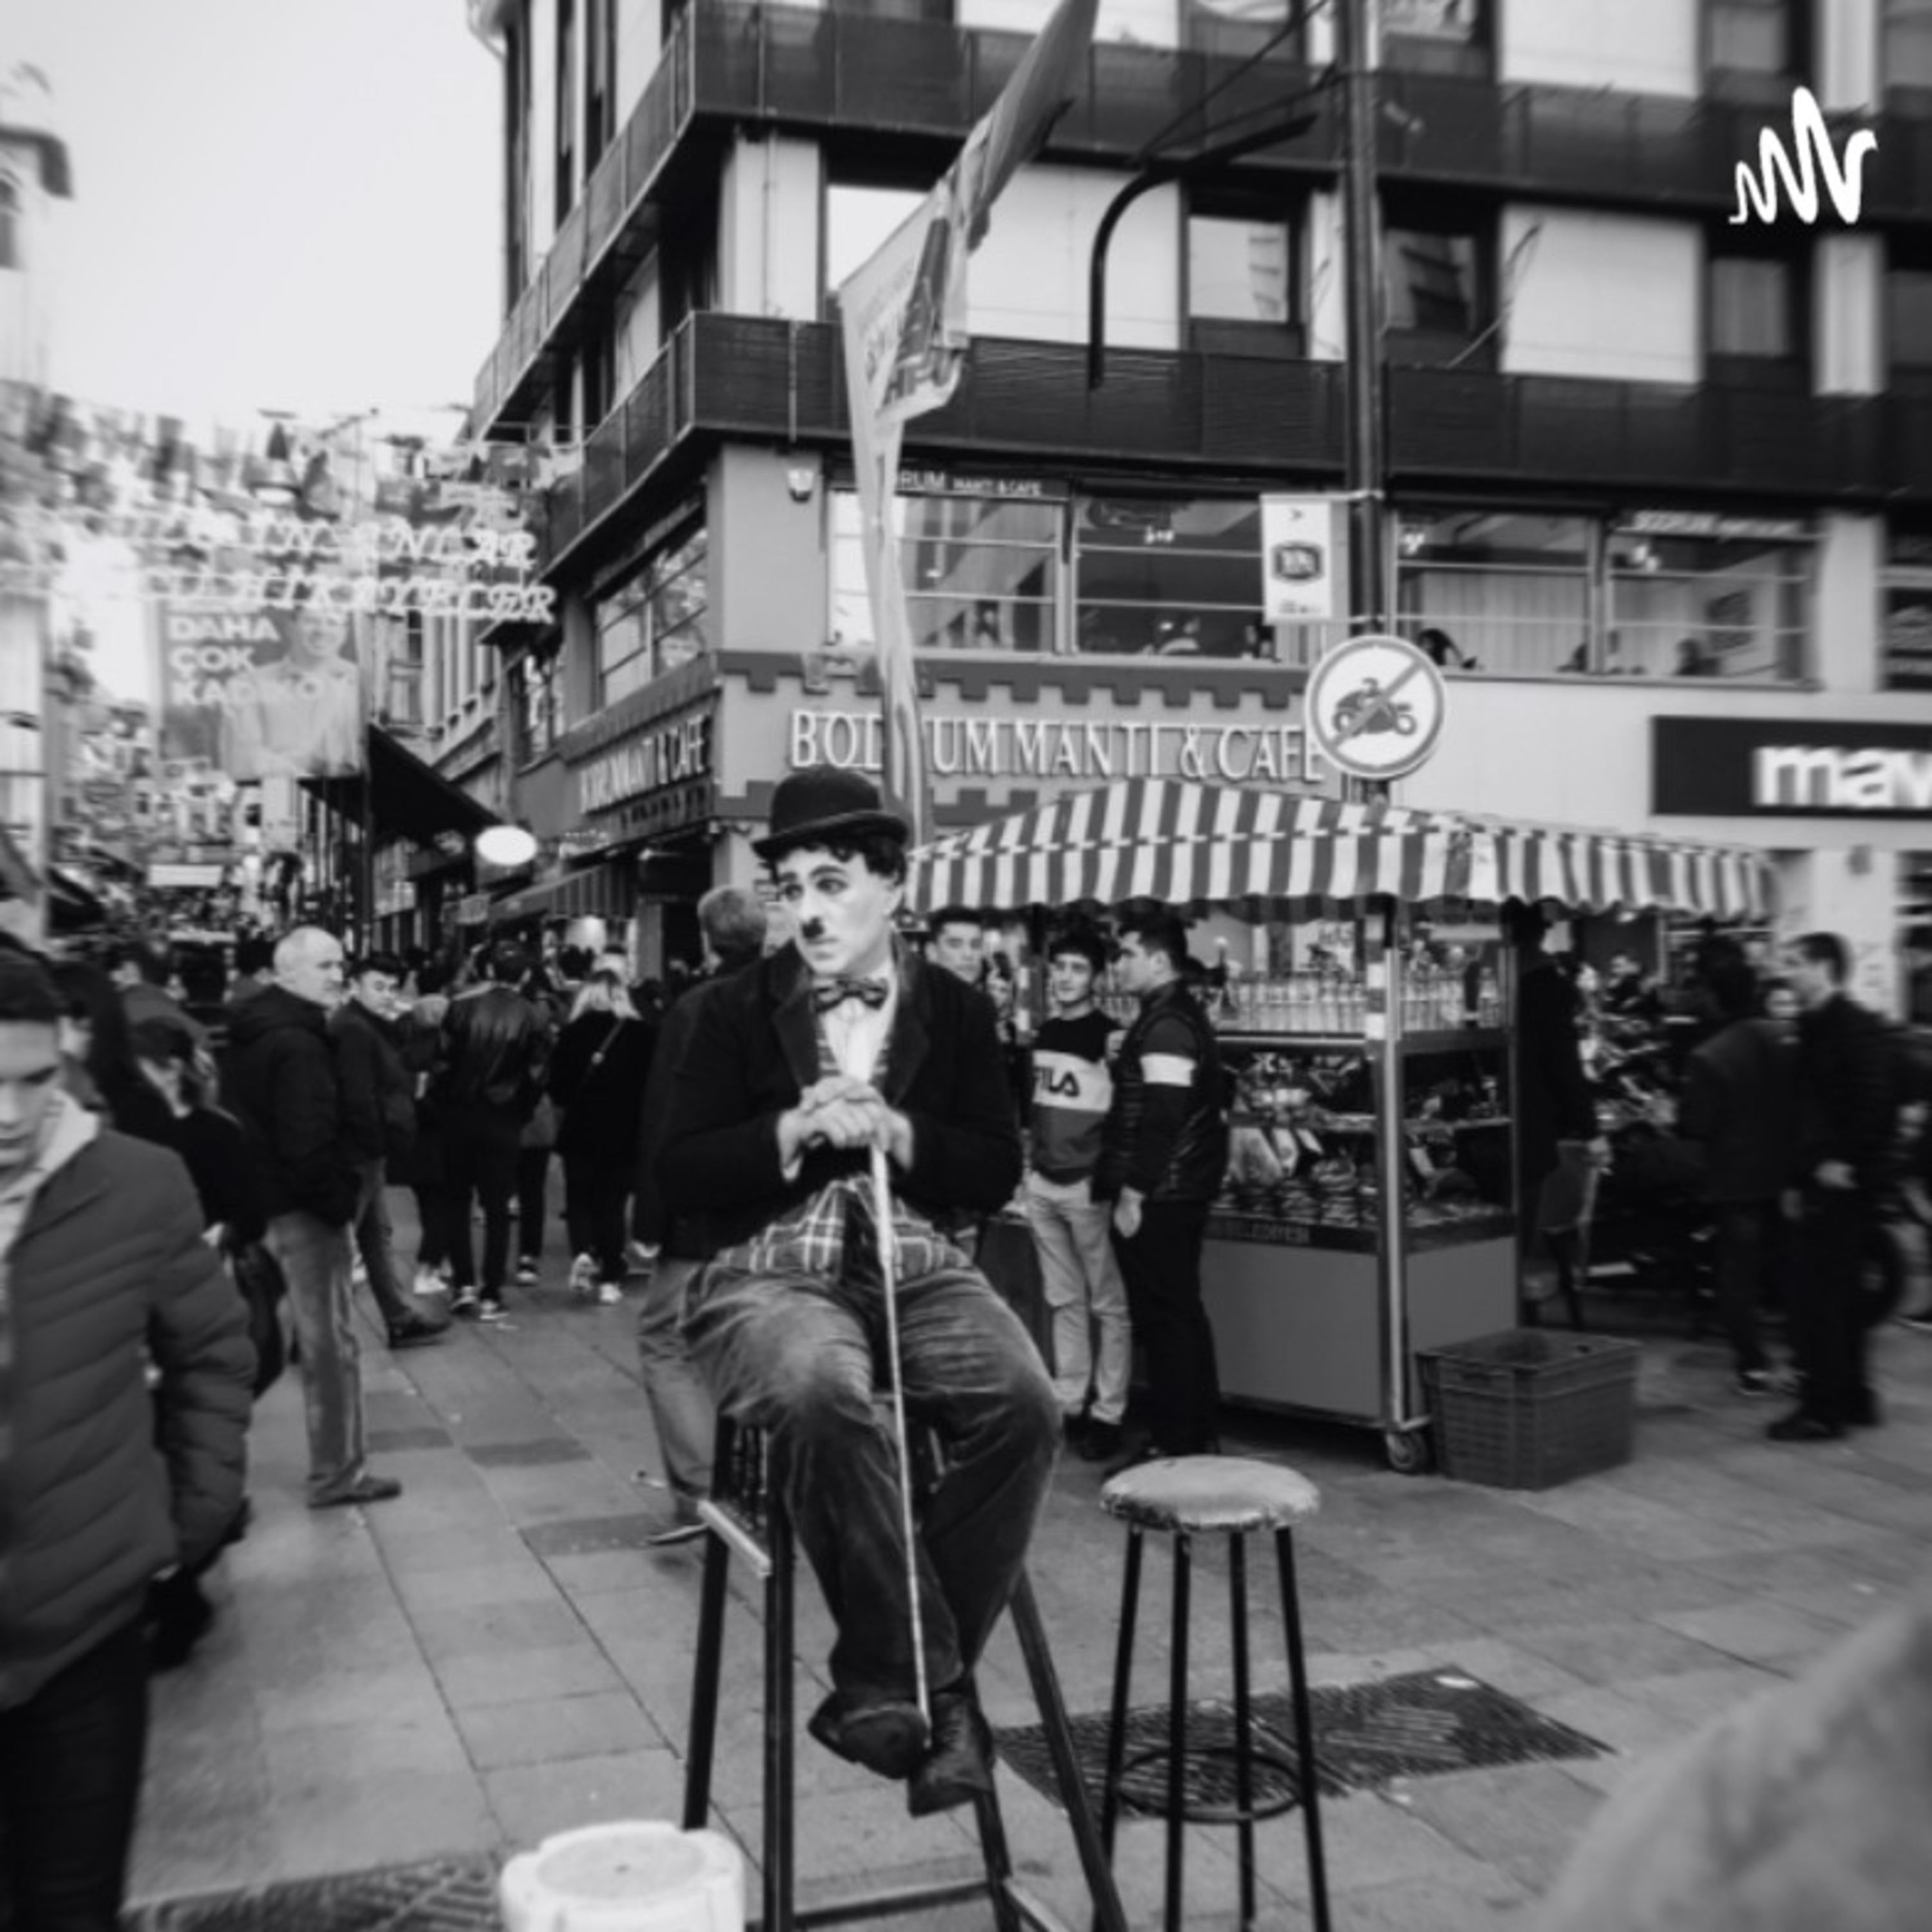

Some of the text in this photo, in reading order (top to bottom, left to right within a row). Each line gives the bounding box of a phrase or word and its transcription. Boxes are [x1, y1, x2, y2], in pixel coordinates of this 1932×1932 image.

[168, 615, 281, 641] DAHA
[793, 710, 1325, 781] BODUM MANTI & CAFE
